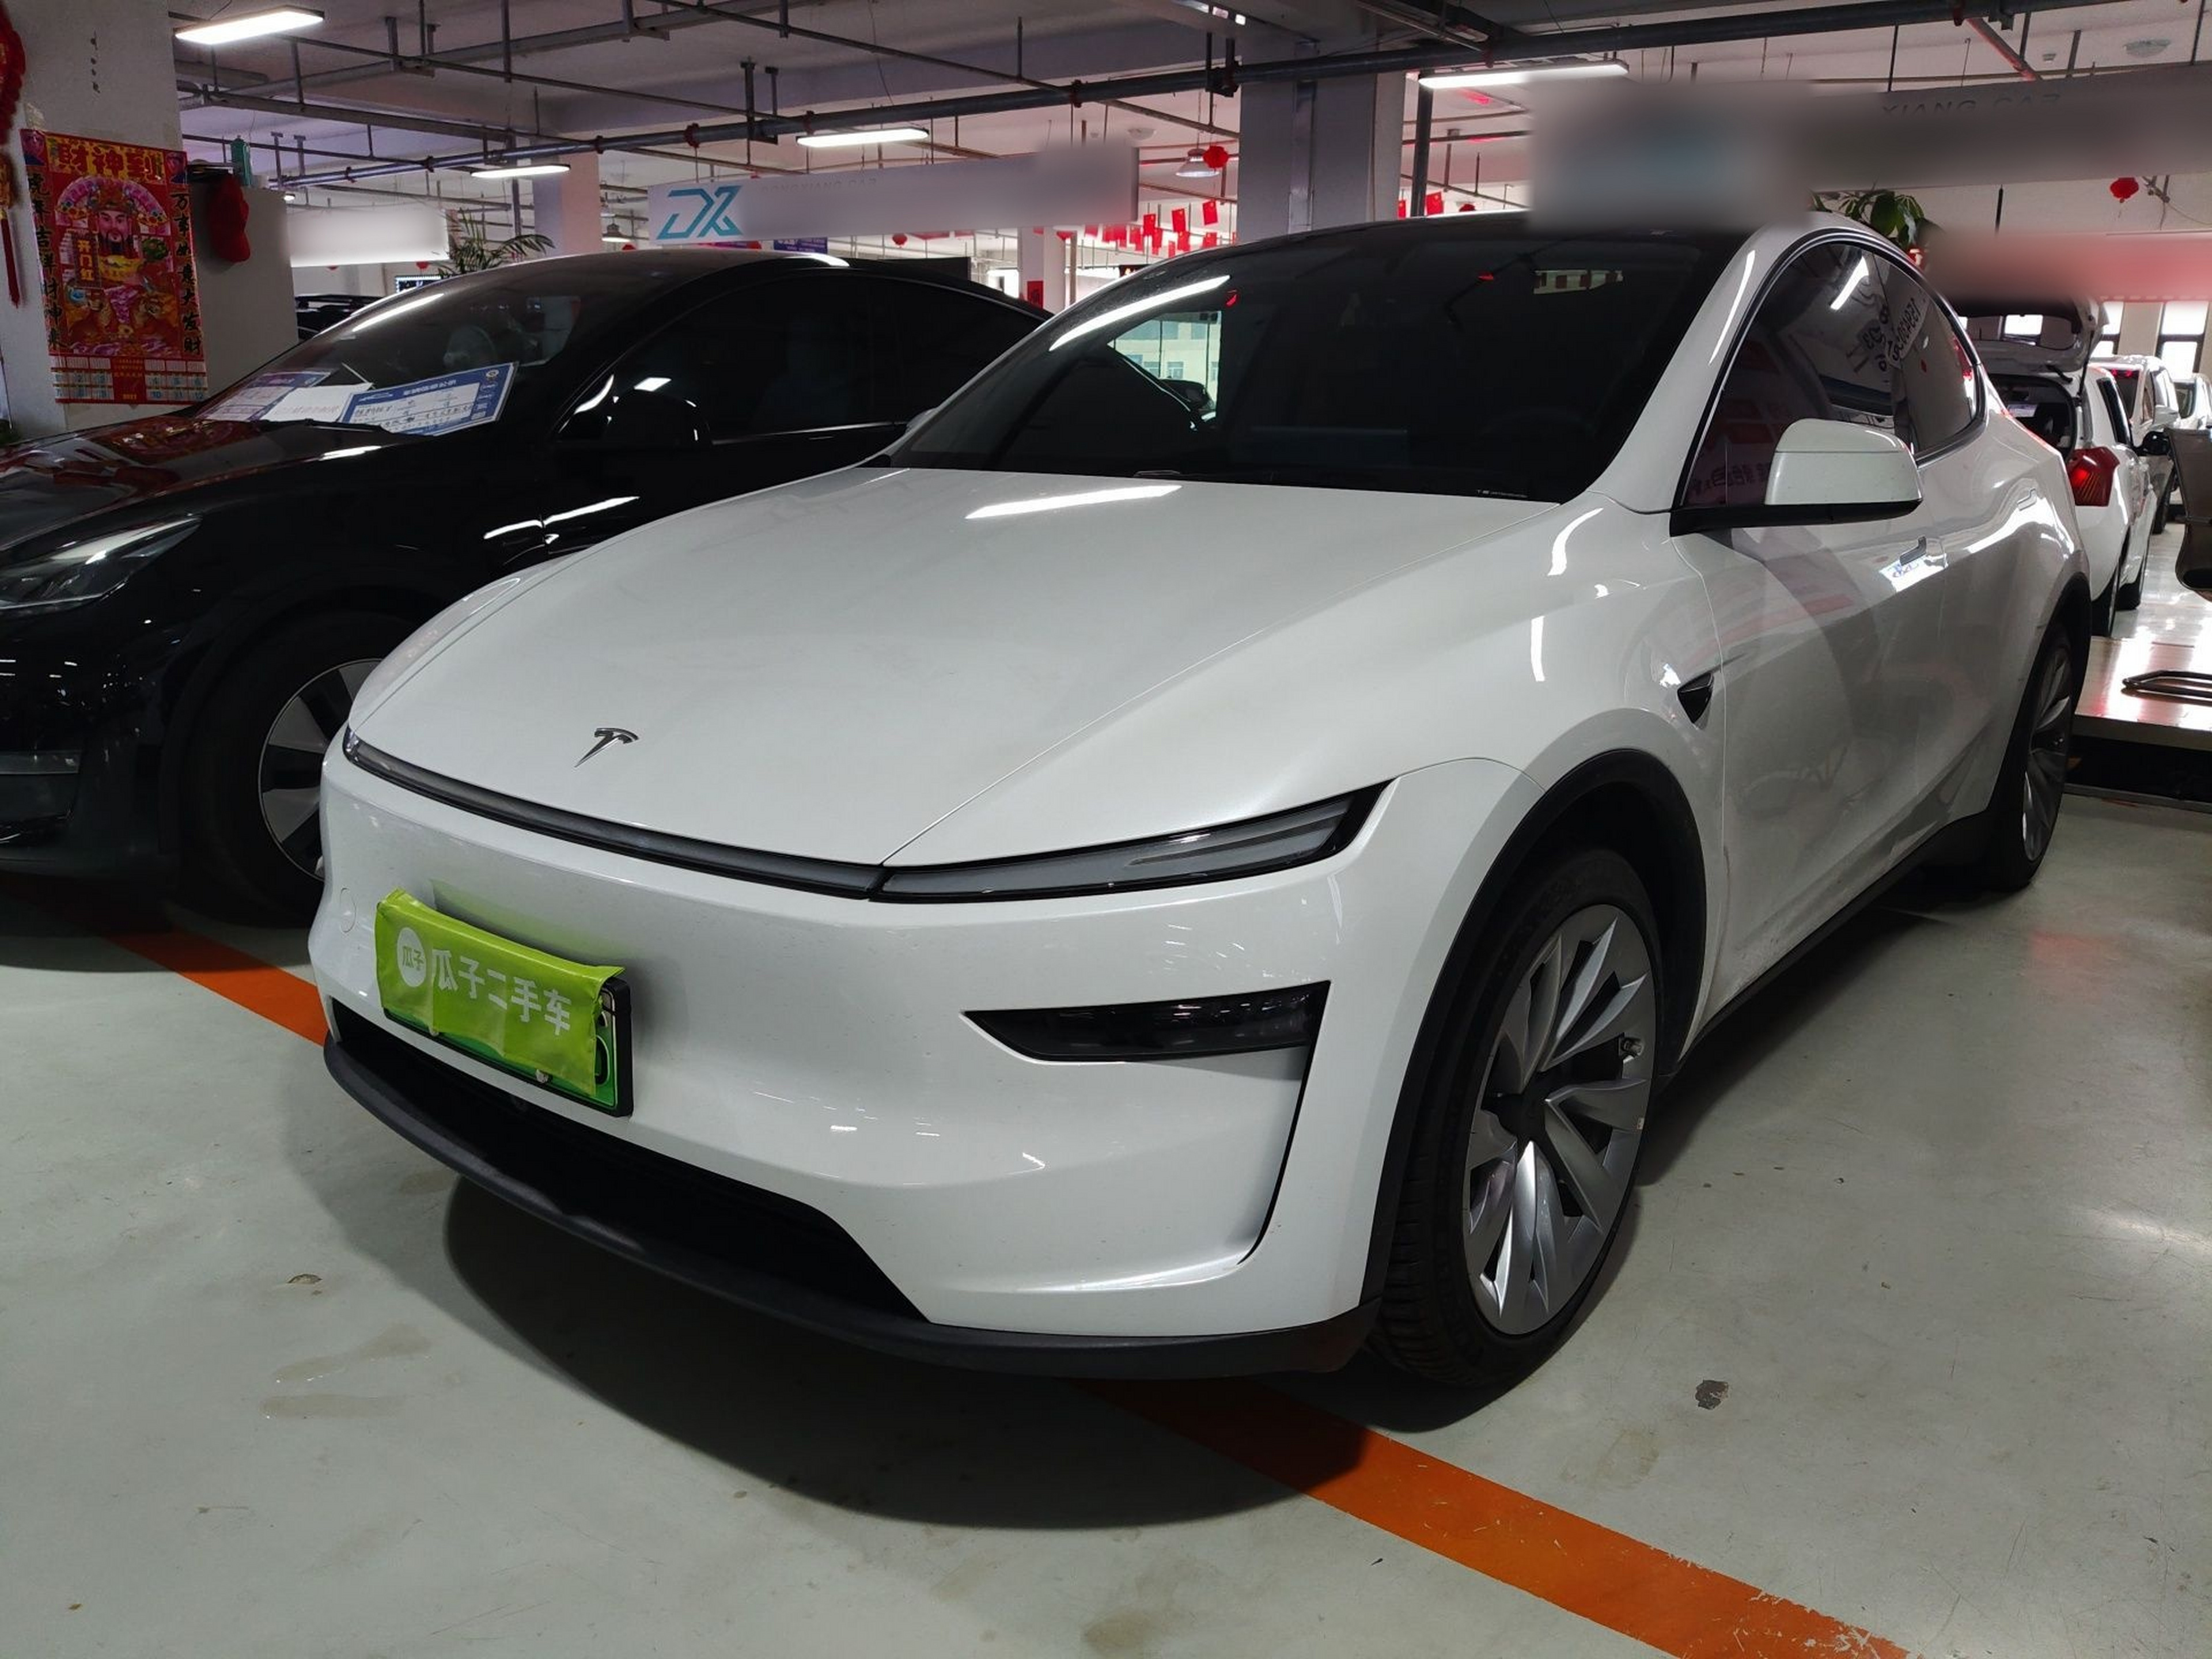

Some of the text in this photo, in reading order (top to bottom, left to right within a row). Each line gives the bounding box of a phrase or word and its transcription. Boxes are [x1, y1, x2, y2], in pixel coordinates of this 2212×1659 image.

[77, 239, 94, 282] 开门红
[403, 946, 425, 971] 瓜子
[432, 948, 572, 1036] 瓜子二手车
